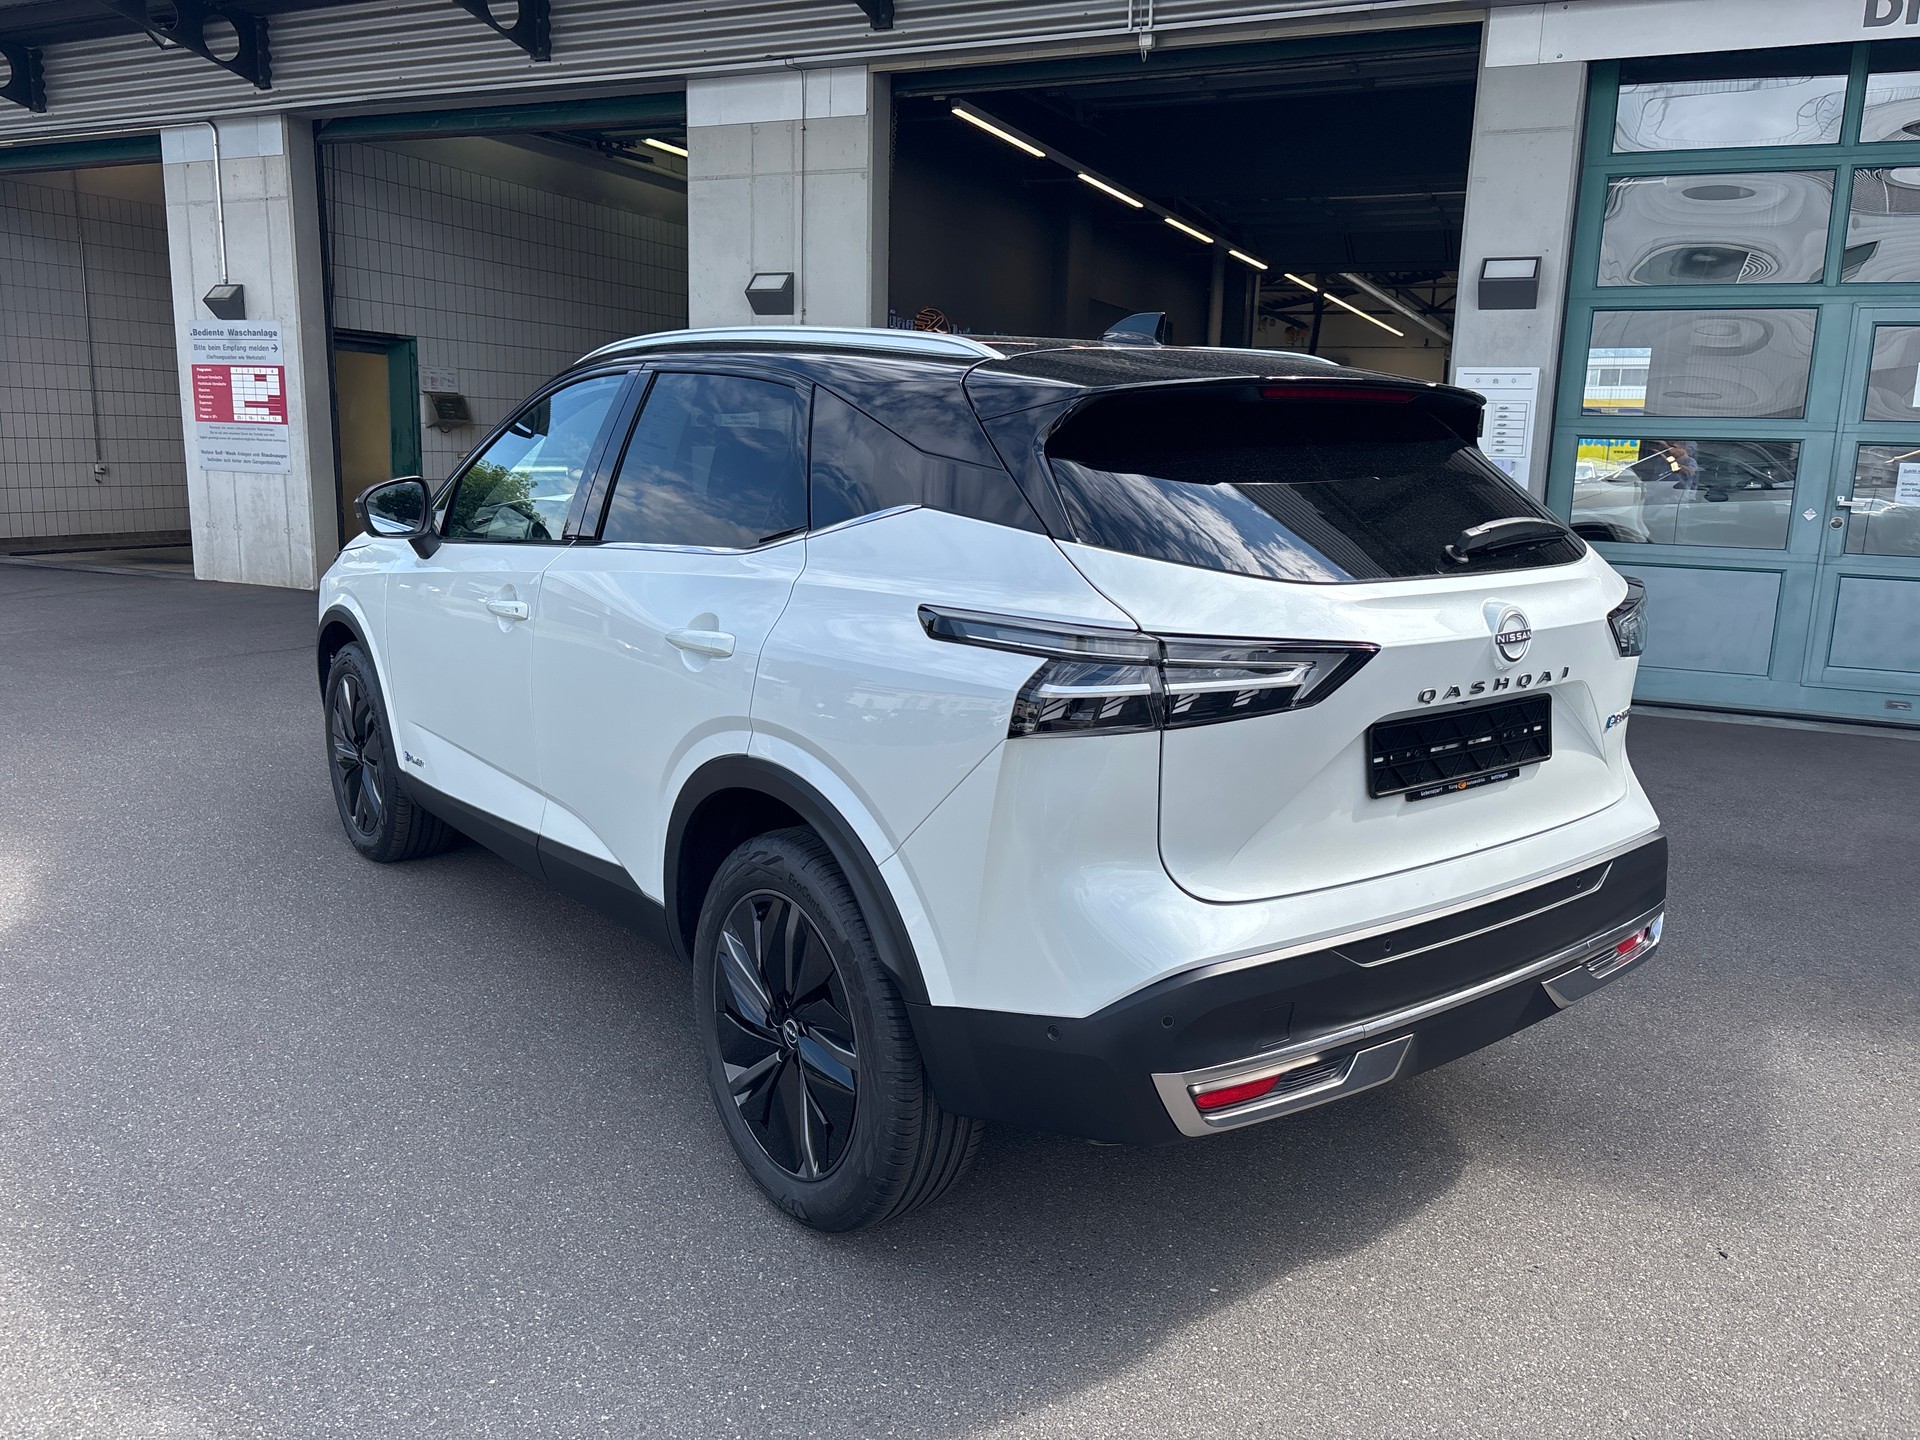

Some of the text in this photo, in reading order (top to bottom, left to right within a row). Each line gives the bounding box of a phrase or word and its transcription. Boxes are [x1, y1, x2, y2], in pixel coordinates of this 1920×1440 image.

[192, 328, 278, 339] Bediente Waschanlage
[223, 344, 247, 353] Empfang
[248, 344, 270, 352] melden
[1497, 630, 1532, 644] NISSAN
[1417, 665, 1570, 704] QASHQAI
